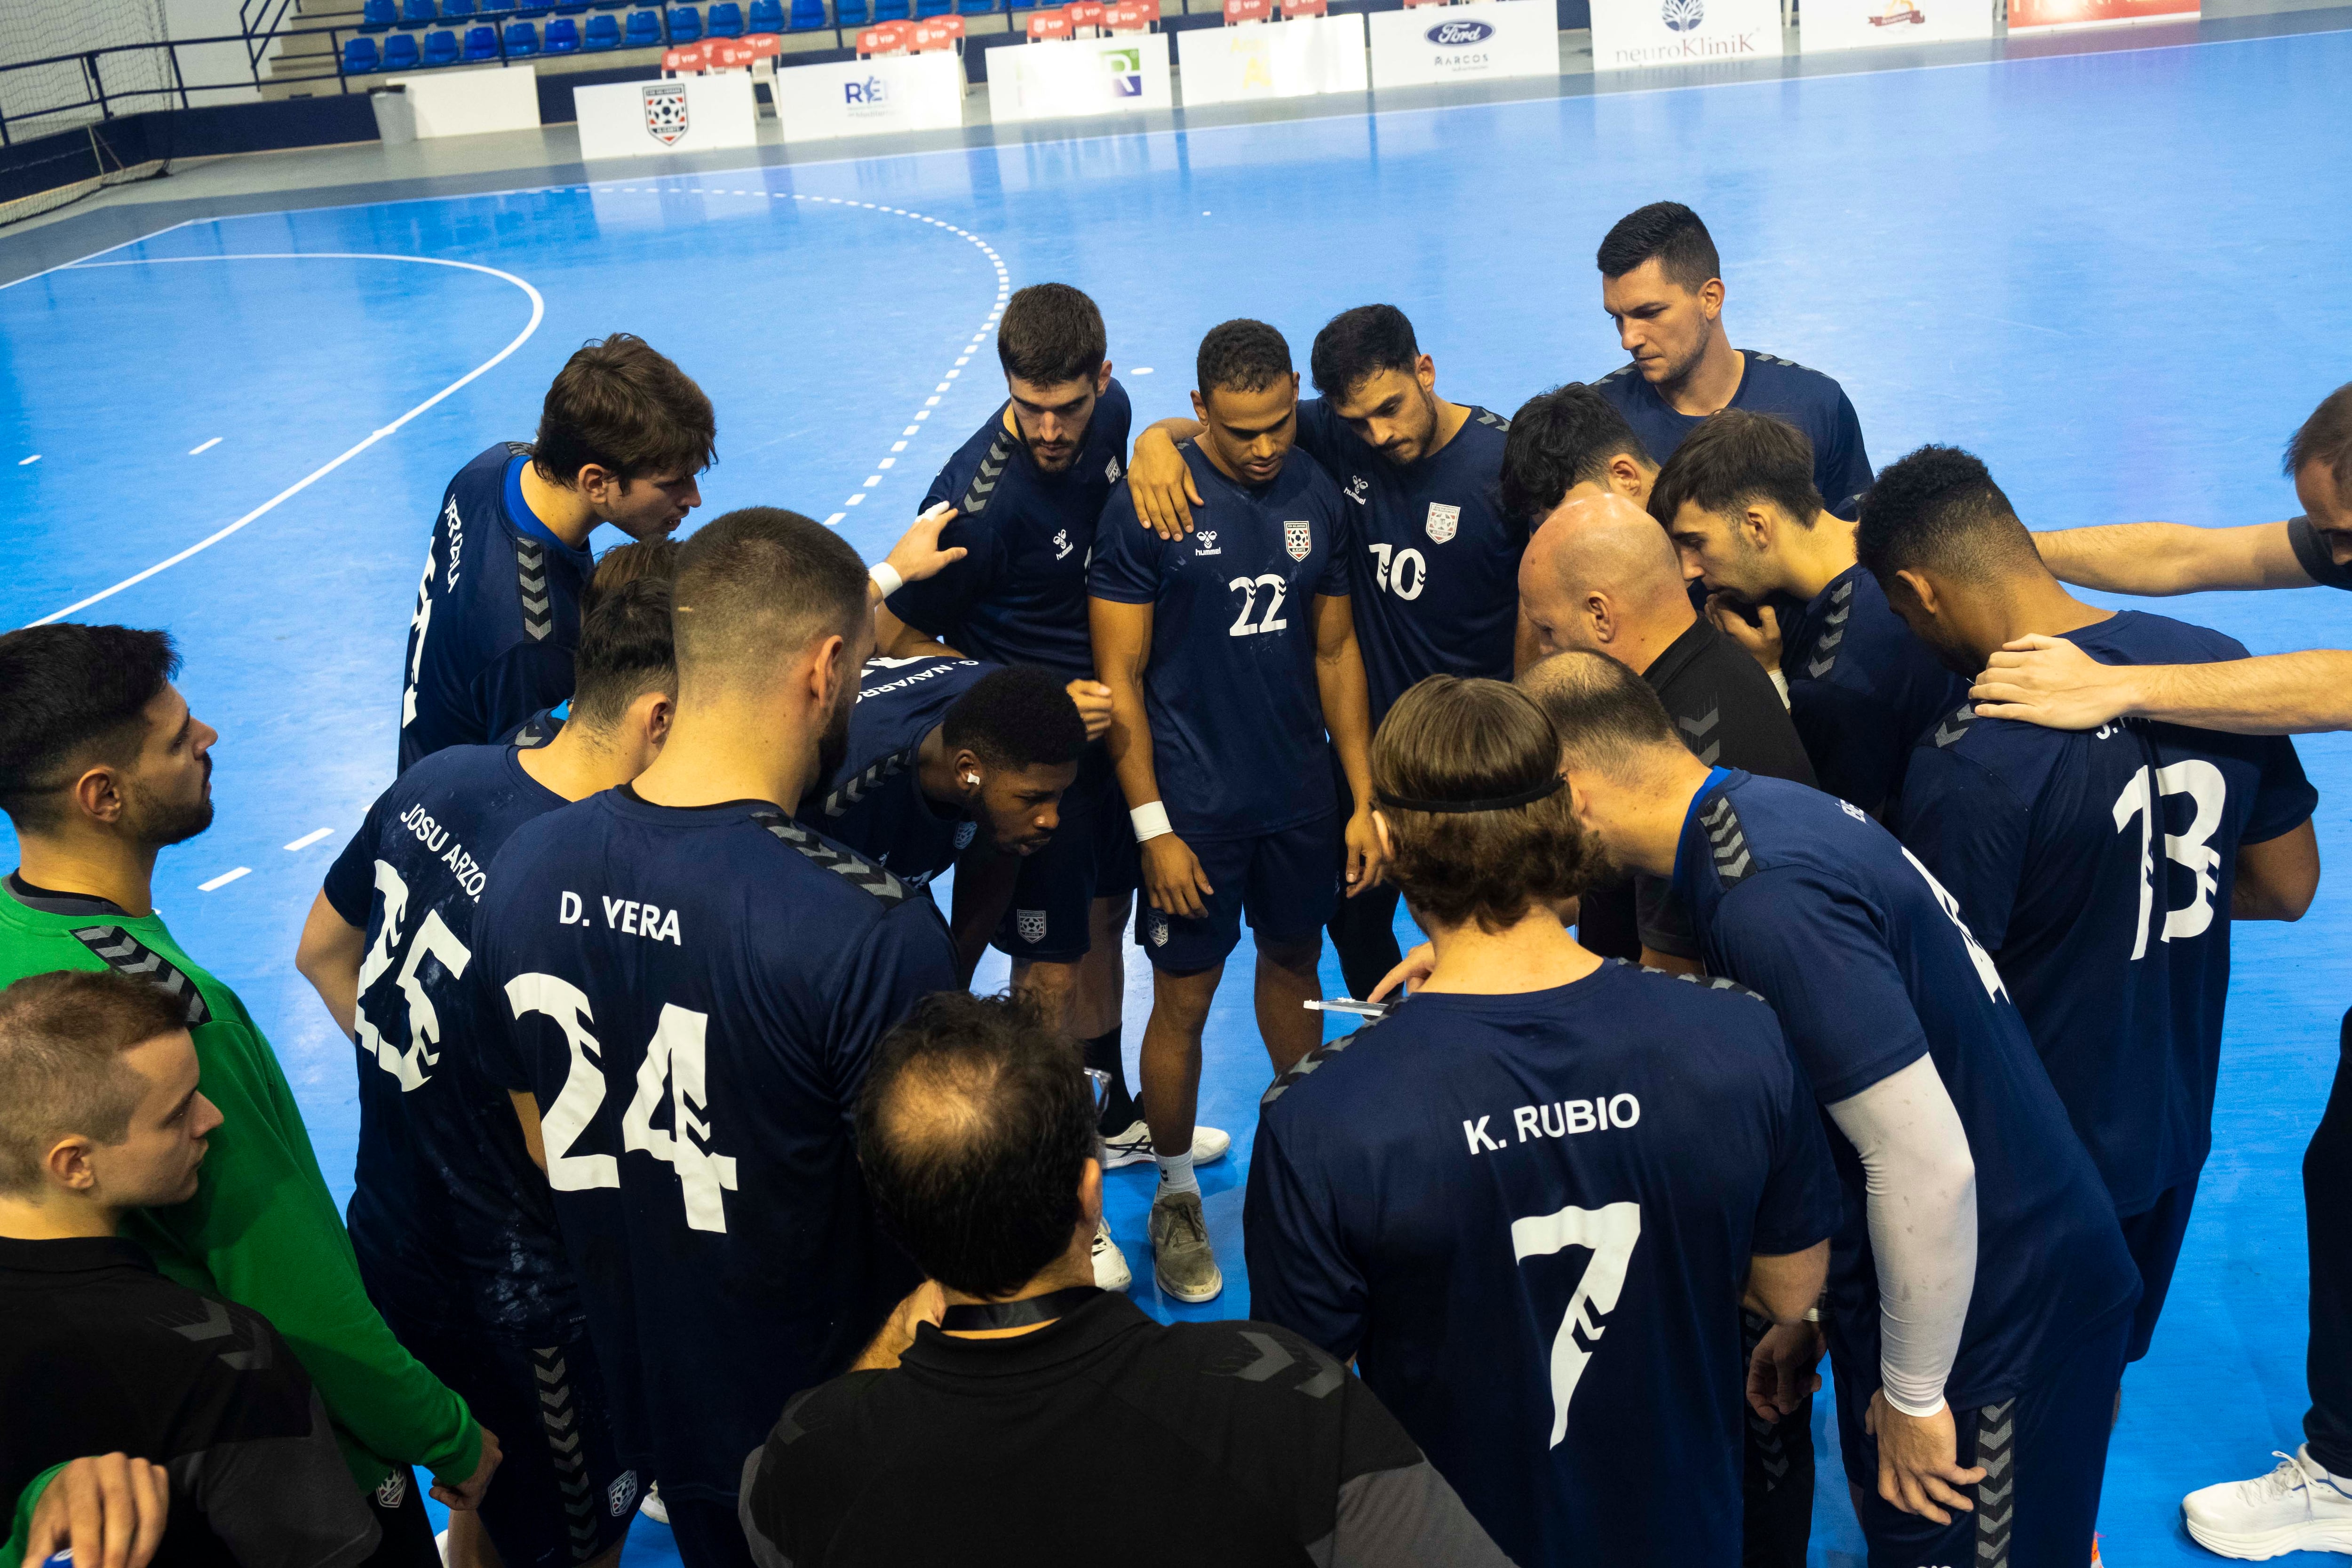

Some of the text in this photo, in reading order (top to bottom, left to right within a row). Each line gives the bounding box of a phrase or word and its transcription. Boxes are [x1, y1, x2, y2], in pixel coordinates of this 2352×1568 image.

[1084, 8, 1101, 16] VIP
[1120, 12, 1137, 21] VIP
[1047, 20, 1064, 29] VIP
[1438, 24, 1481, 43] Ford
[756, 38, 773, 48] VIP
[879, 34, 896, 44] VIP
[930, 30, 947, 39] VIP
[736, 50, 753, 59] VIP
[1615, 32, 1754, 63] neuroKliniK
[681, 53, 698, 63] VIP
[1343, 487, 1367, 505] hummel
[1056, 542, 1073, 560] hummel
[1195, 547, 1222, 556] hummel
[1368, 543, 1426, 601] 10
[1229, 573, 1287, 637] 22
[400, 803, 487, 904] JOSU ARZO
[2112, 759, 2226, 961] 13
[559, 891, 590, 927] D.
[354, 859, 472, 1092] 25
[503, 972, 739, 1234] 24
[1463, 1093, 1640, 1155] K. RUBIO
[1510, 1201, 1641, 1451] 7
